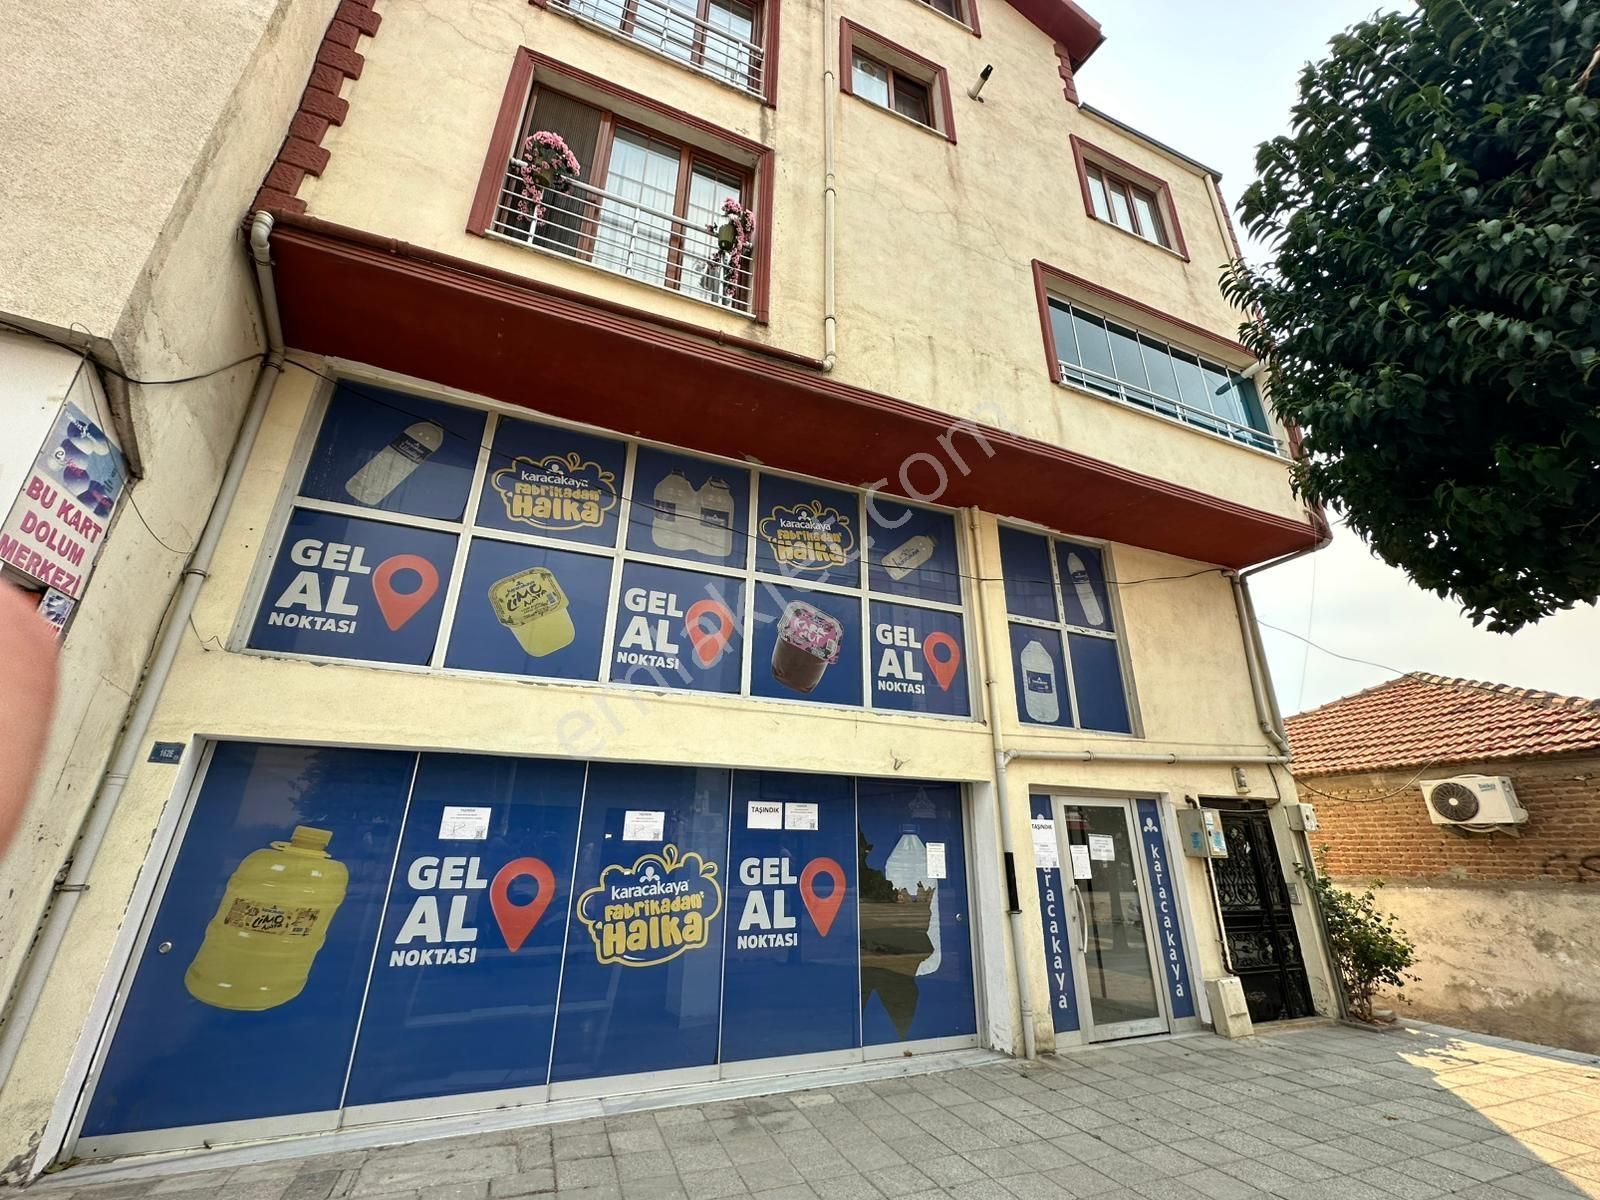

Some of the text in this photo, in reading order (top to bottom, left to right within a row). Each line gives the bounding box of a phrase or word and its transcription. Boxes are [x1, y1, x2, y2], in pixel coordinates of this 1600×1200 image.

[521, 470, 589, 488] karacakaya
[26, 475, 57, 509] BU
[56, 498, 102, 543] KART
[512, 494, 599, 522] Halka
[20, 510, 85, 567] DOLUM
[780, 518, 831, 531] karacakaya
[0, 533, 82, 596] MERKEZİ
[290, 538, 371, 574] GEL
[777, 540, 843, 563] Halka
[275, 571, 359, 616] AL
[624, 587, 683, 618] GEL
[268, 611, 357, 634] NOKTASI
[620, 616, 679, 654] AL
[876, 623, 922, 648] GEL
[616, 651, 680, 671] NOKTASI
[878, 649, 923, 681] AL
[877, 680, 926, 695] NOKTASI
[751, 806, 780, 814] TAŞINDIK
[408, 856, 488, 889] GEL
[739, 857, 797, 886] GEL
[611, 880, 689, 900] karacakaya
[395, 896, 478, 944] AL
[738, 890, 796, 930] AL
[1151, 844, 1184, 998] karacakaya
[603, 911, 702, 957] Halka
[737, 933, 798, 950] NOKTASI
[389, 947, 477, 967] NOKTASI
